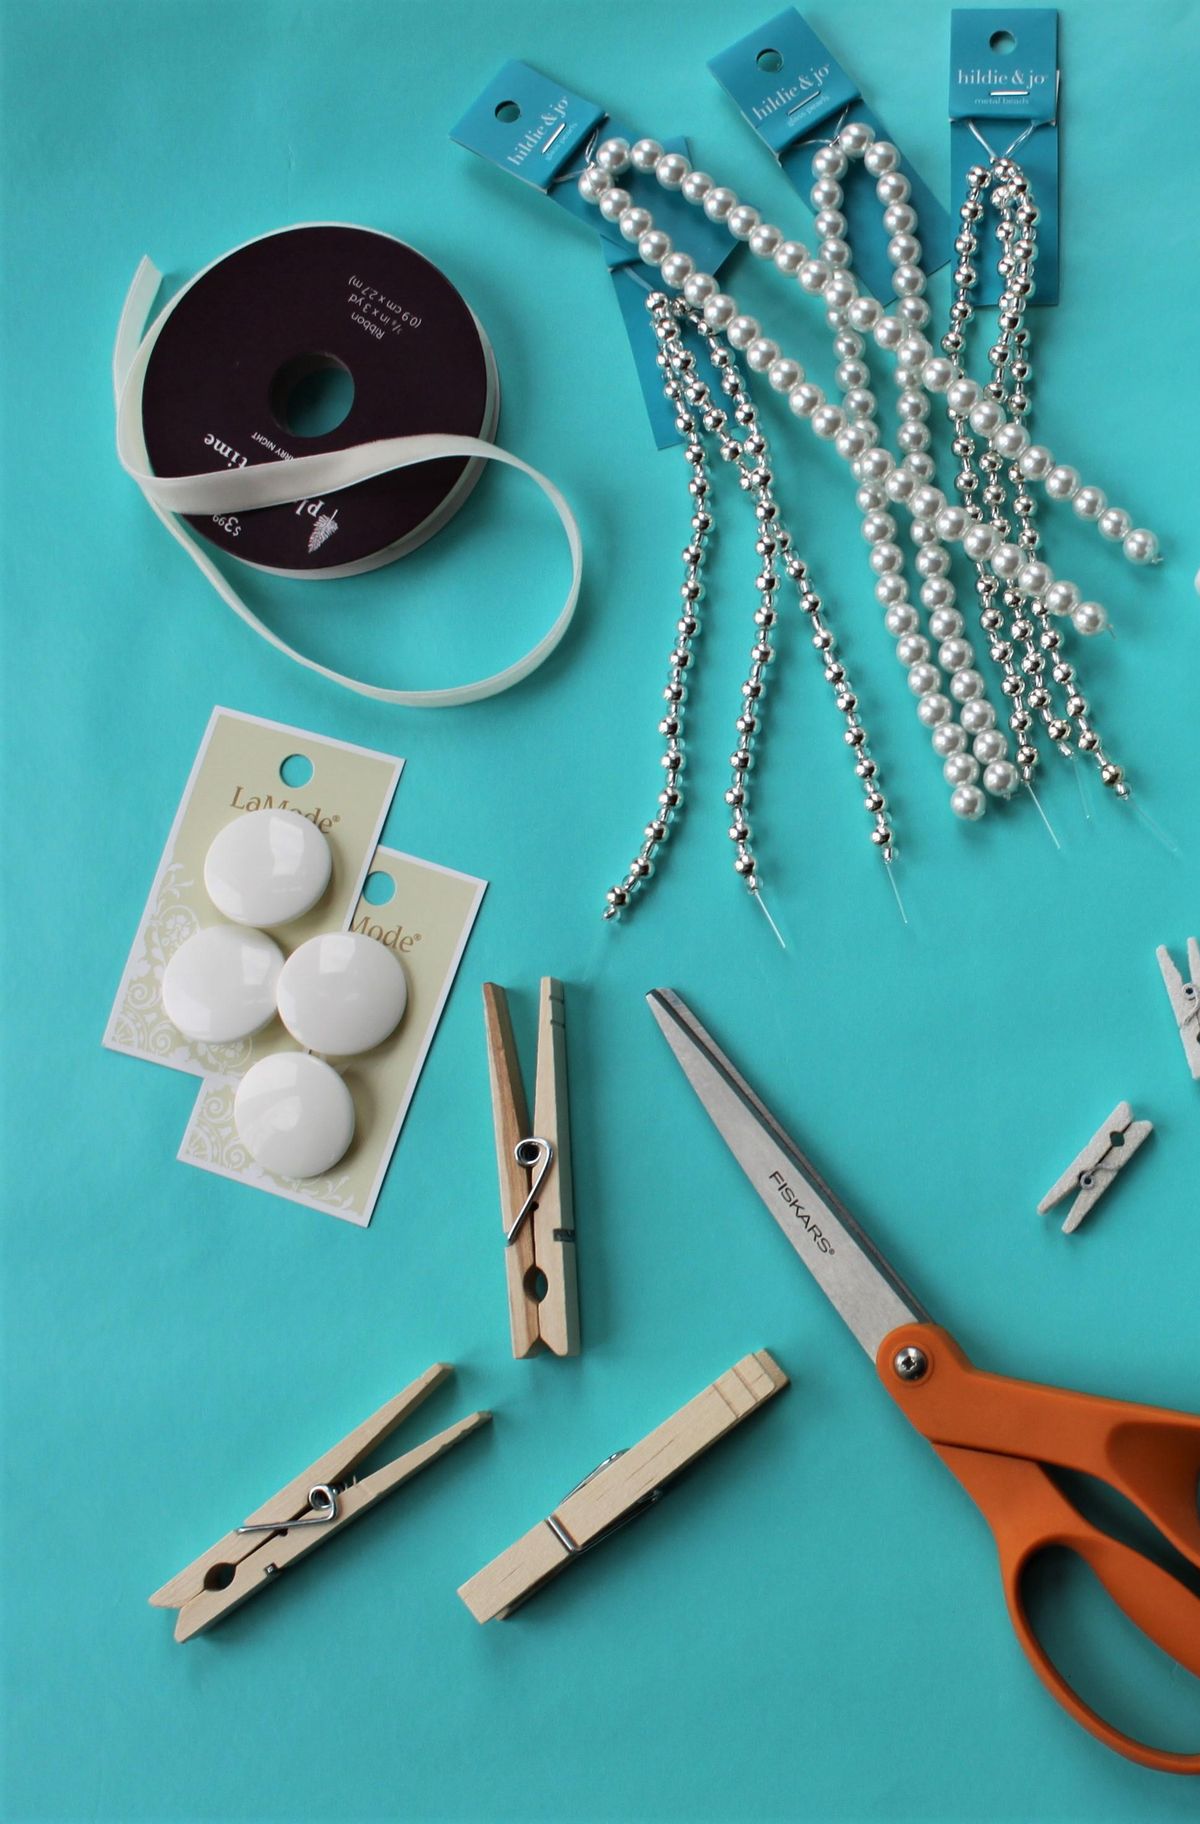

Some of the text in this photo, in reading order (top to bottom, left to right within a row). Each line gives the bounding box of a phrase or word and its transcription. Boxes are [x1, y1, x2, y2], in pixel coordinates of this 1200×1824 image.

[958, 69, 1008, 85] hildie
[1011, 69, 1024, 85] &
[752, 86, 798, 121] hildie
[798, 74, 814, 90] &
[507, 126, 545, 166] hildie
[540, 113, 557, 126] &
[348, 275, 364, 289] m)
[347, 293, 365, 307] yd
[378, 295, 386, 304] x
[362, 303, 372, 313] 3
[371, 308, 379, 316] x
[386, 300, 402, 314] cm
[351, 312, 385, 340] Ribbon
[380, 313, 391, 325] in
[251, 432, 294, 461] RRY NIGHT
